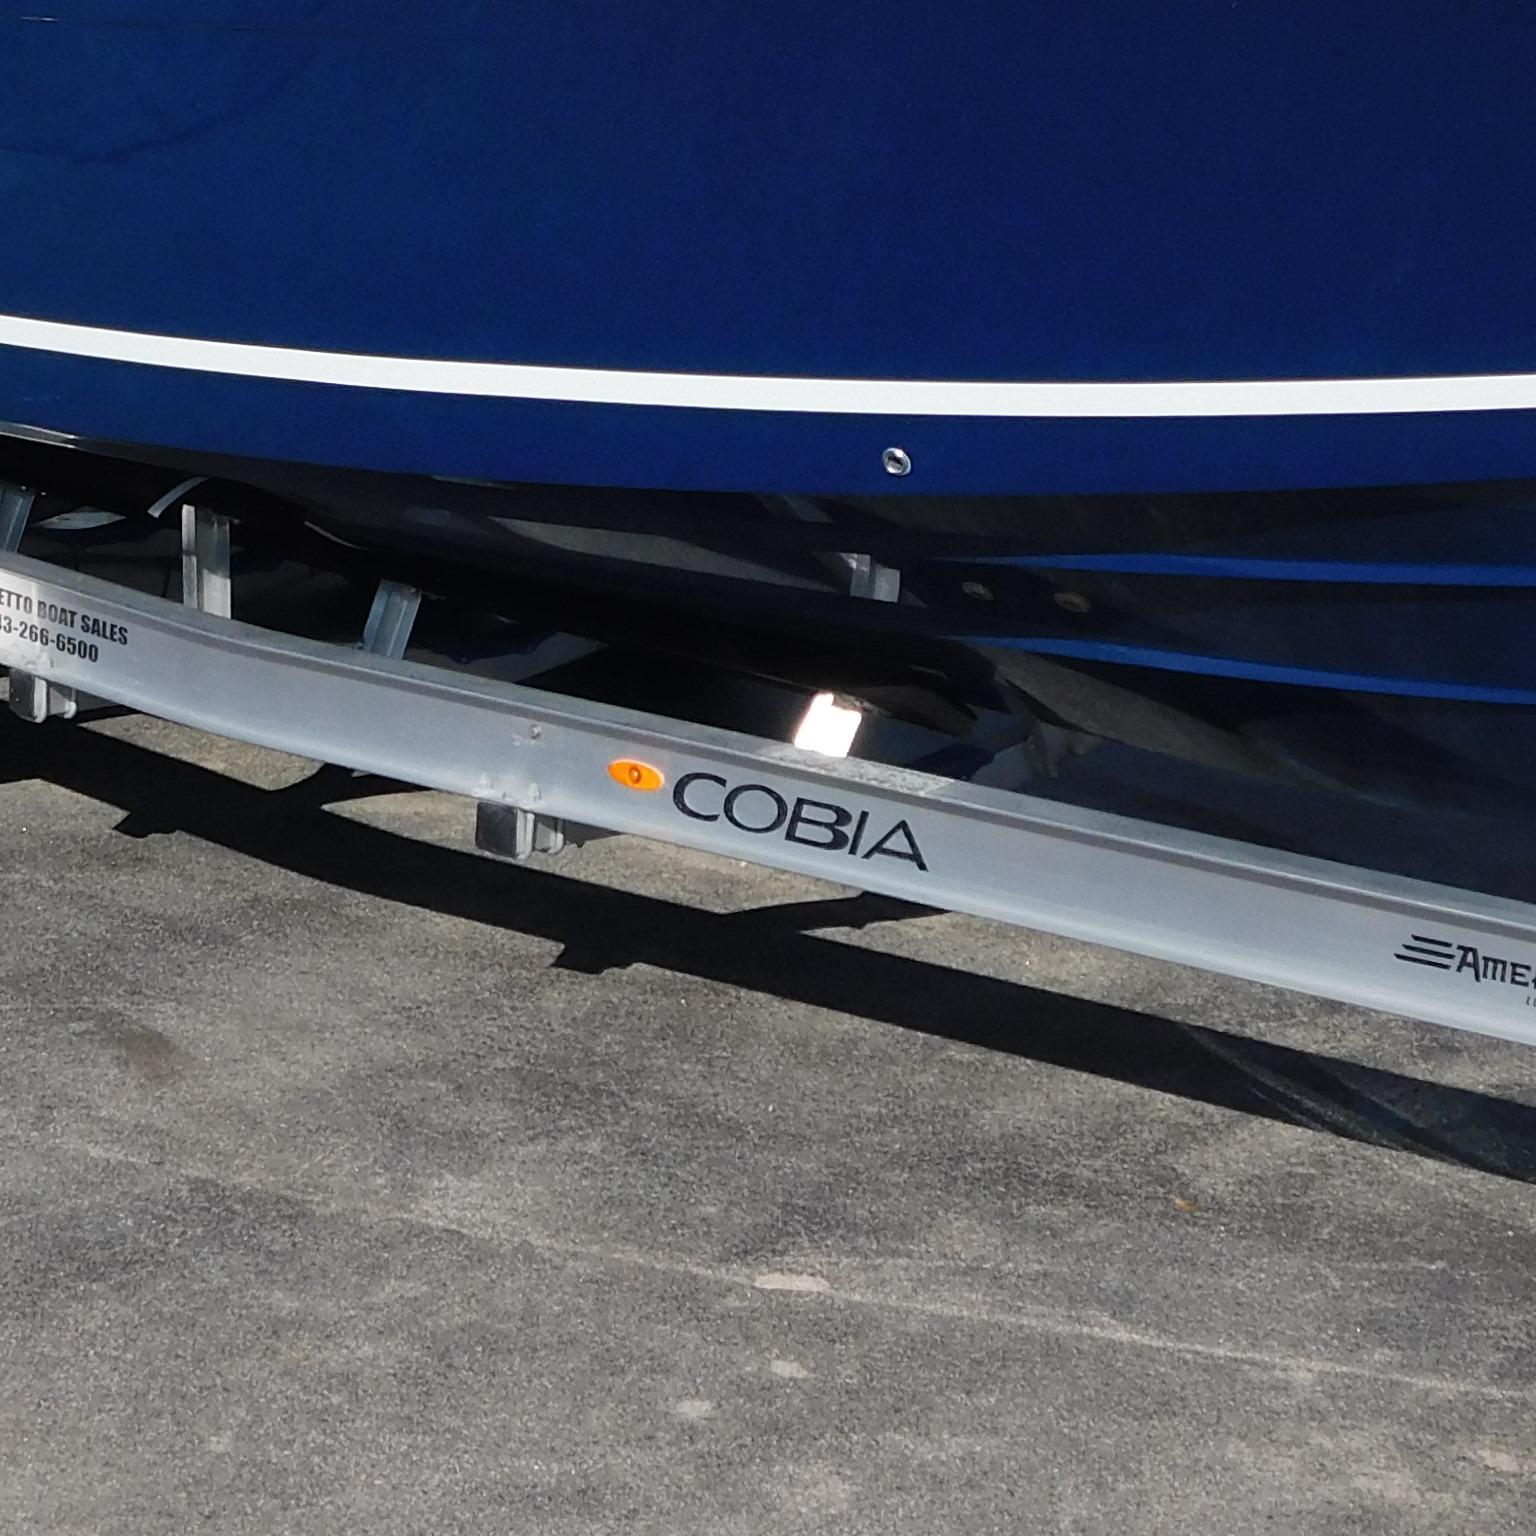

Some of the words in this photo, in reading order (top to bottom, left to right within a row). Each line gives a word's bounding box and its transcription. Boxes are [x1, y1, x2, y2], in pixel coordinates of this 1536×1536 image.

[37, 599, 77, 629] BOAT
[81, 614, 128, 646] SALES
[672, 772, 930, 873] COBIA
